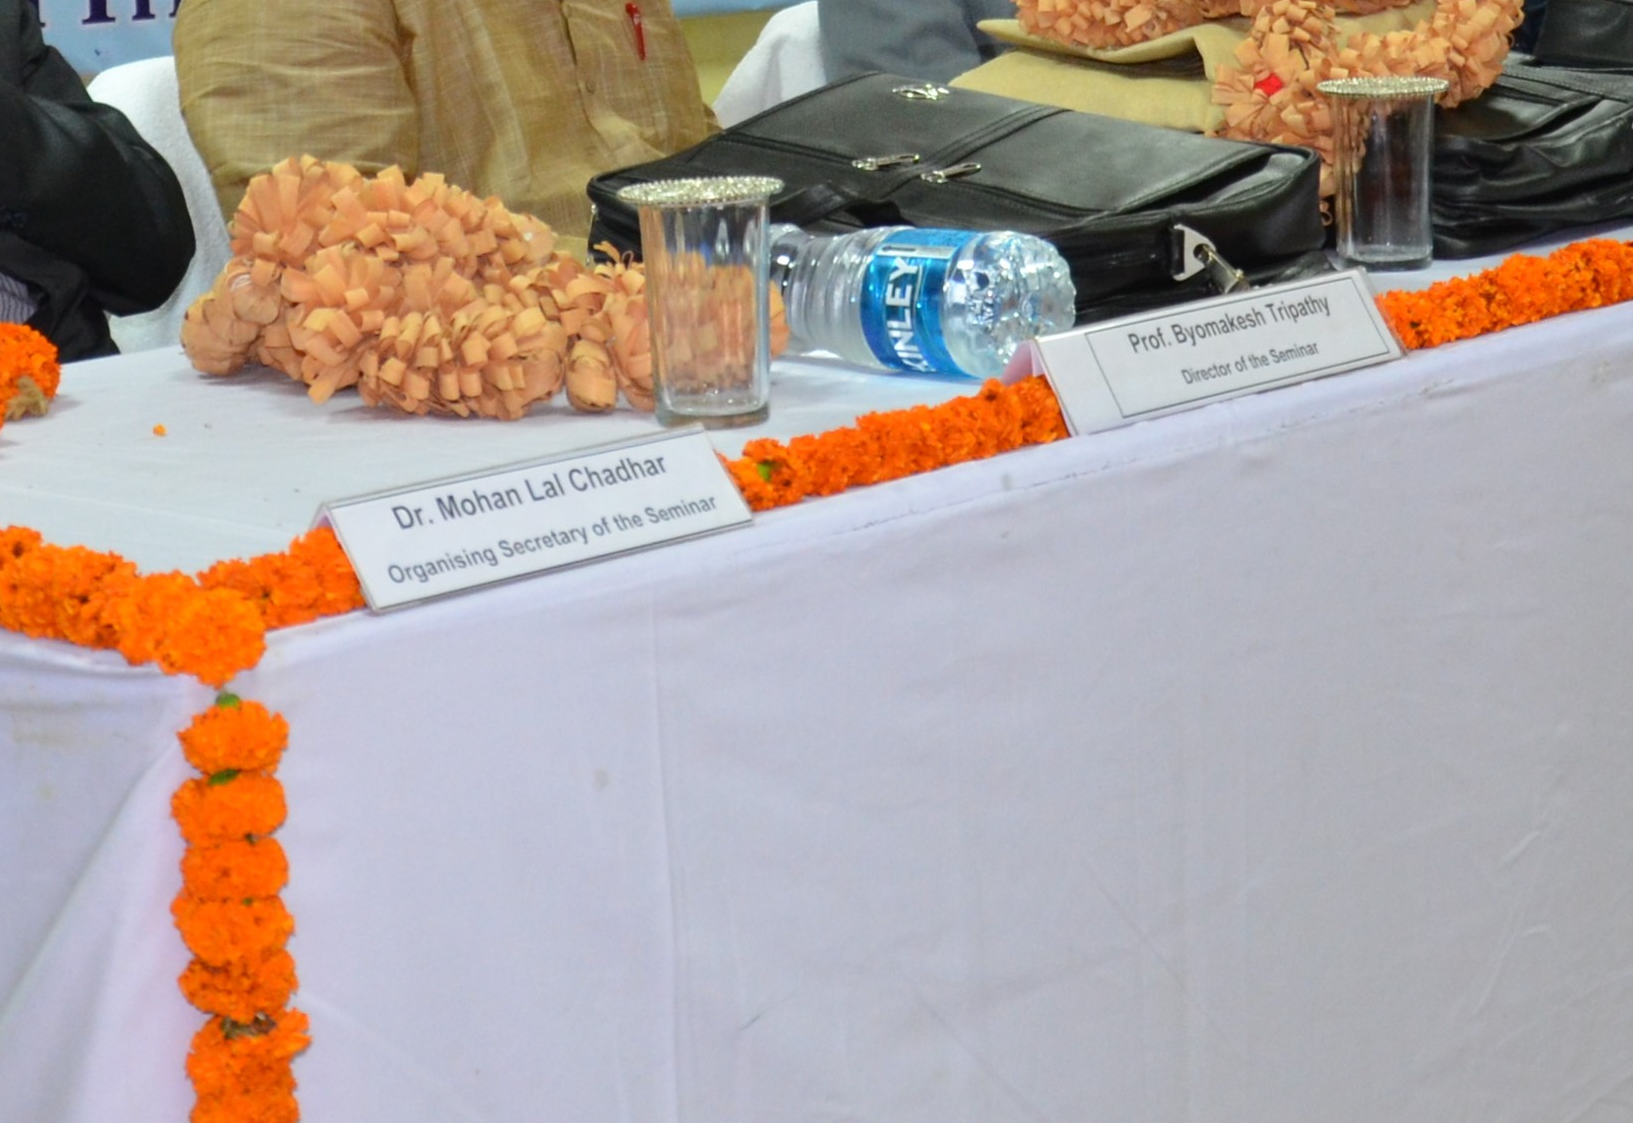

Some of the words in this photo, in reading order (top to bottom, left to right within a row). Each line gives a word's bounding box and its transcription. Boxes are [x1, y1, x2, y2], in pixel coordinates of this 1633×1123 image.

[1127, 326, 1173, 355] Prof.
[1171, 306, 1266, 345] Byomakesh
[1265, 292, 1332, 324] Tripathy
[1180, 358, 1233, 386] Director
[1234, 356, 1249, 374] of
[1247, 350, 1270, 371] the
[1269, 341, 1321, 365] Seminar
[391, 504, 435, 531] Dr.
[435, 486, 524, 522] Mohan
[523, 471, 566, 504] Lal
[568, 453, 667, 494] Chadhar
[387, 540, 500, 585] Organising
[497, 523, 590, 559] Secretary
[591, 514, 611, 537] of
[610, 505, 645, 533] the
[647, 493, 719, 526] Seminar
